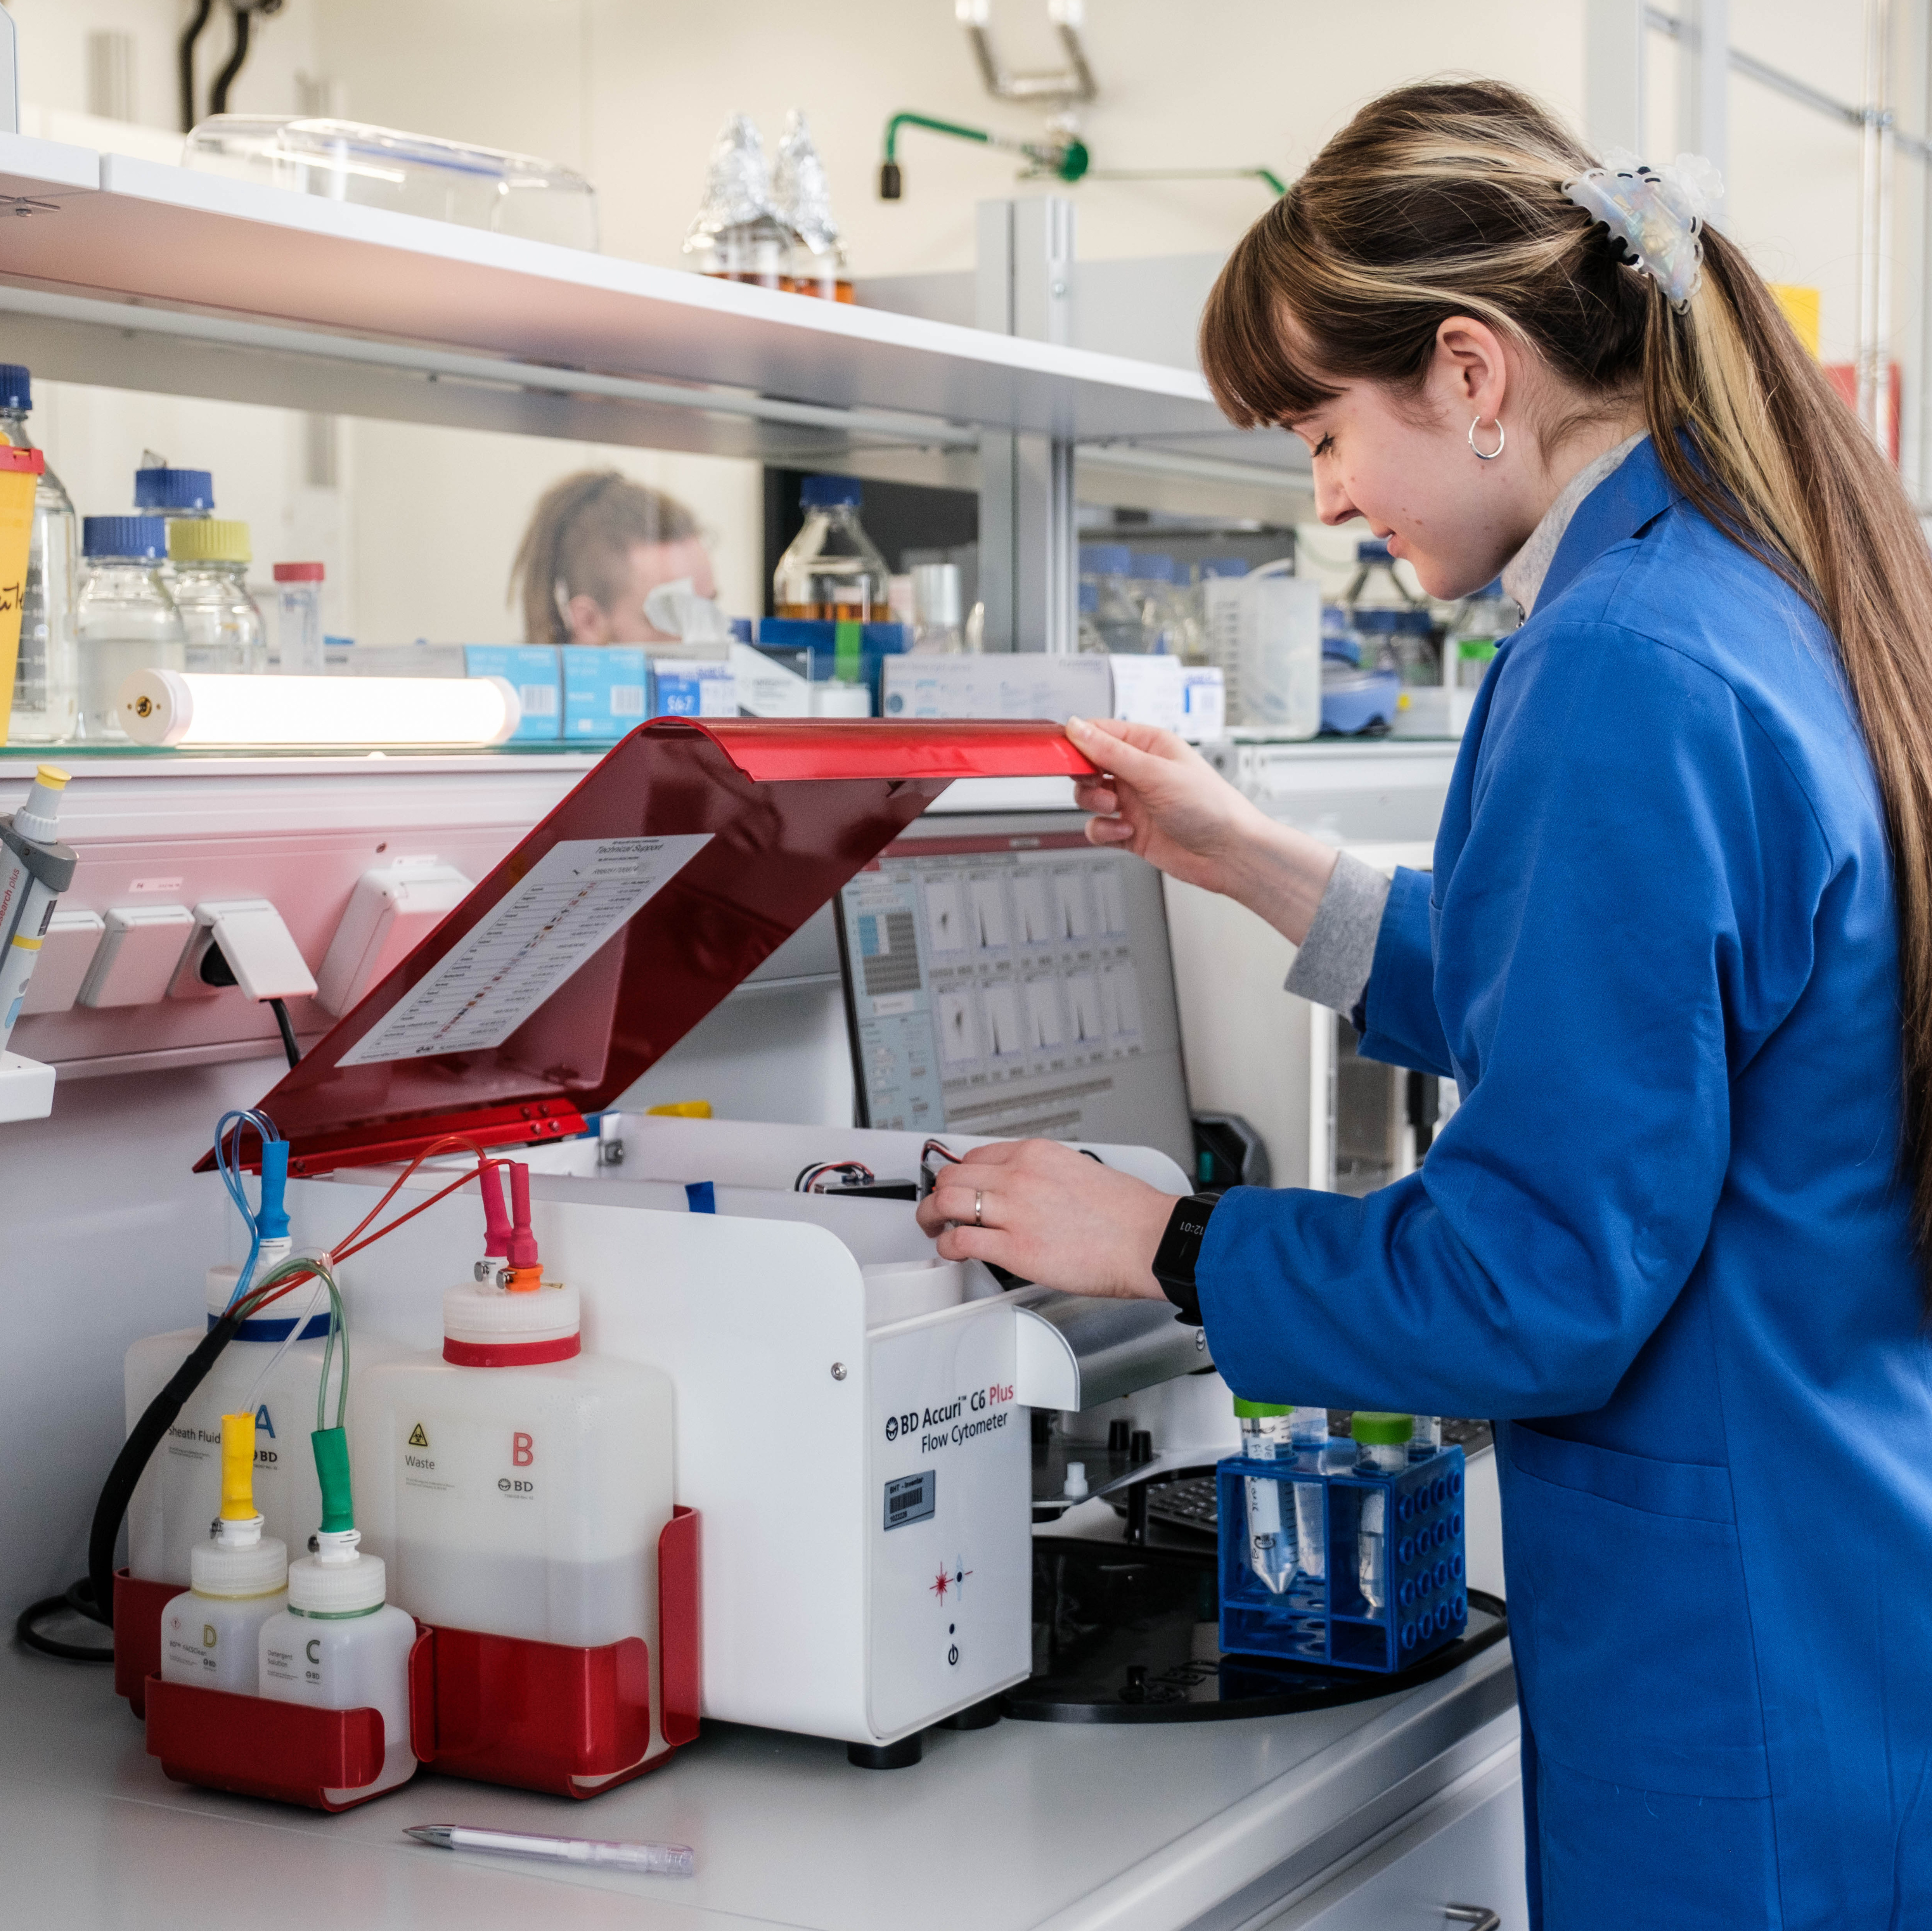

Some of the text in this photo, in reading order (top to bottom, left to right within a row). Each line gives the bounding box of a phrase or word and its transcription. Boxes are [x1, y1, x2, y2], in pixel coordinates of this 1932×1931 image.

[596, 842, 664, 854] Technical Support
[9, 868, 20, 889] plus
[1180, 1221, 1203, 1235] 12:01
[900, 1412, 919, 1435] BD
[971, 1389, 985, 1411] C6
[990, 1383, 1013, 1405] Plus
[255, 1404, 275, 1439] A
[198, 1429, 221, 1444] Fluid
[922, 1412, 1008, 1453] Flow Cytometer
[260, 1450, 277, 1462] BD
[512, 1432, 533, 1467] B
[405, 1455, 435, 1470] Waste
[514, 1481, 533, 1492] BD
[890, 1484, 900, 1494] BHT
[204, 1624, 216, 1648] D
[267, 1650, 293, 1660] Detergent
[306, 1640, 320, 1664] C
[268, 1659, 288, 1668] Solution
